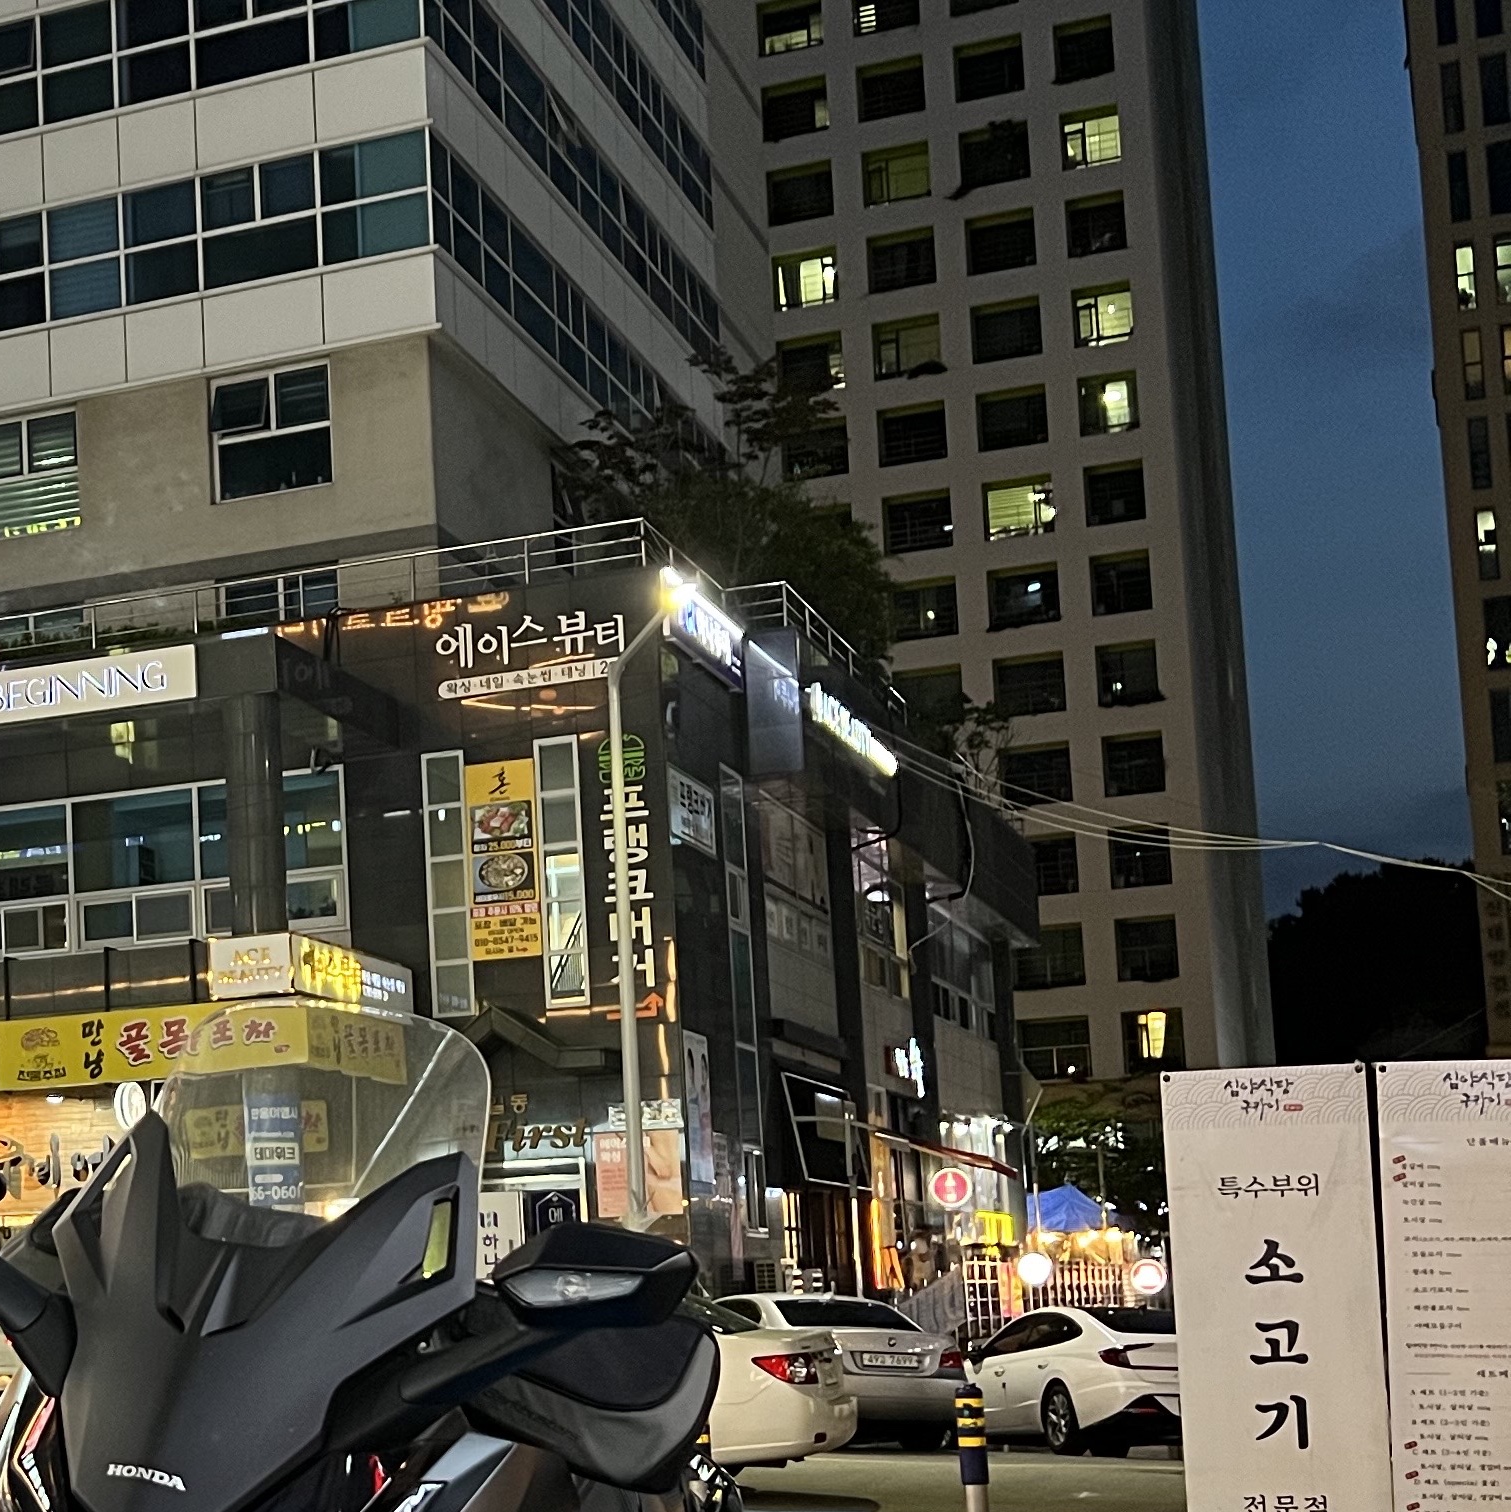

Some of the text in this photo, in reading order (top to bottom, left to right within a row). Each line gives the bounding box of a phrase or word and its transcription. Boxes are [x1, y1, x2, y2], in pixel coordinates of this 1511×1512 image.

[436, 611, 626, 668] 에이스뷰티
[232, 946, 271, 965] ACE
[1223, 1077, 1295, 1098] 심야식당
[1217, 1173, 1320, 1199] 특수부위
[1244, 1238, 1310, 1451] 소고기
[106, 1463, 187, 1493] HONDA
